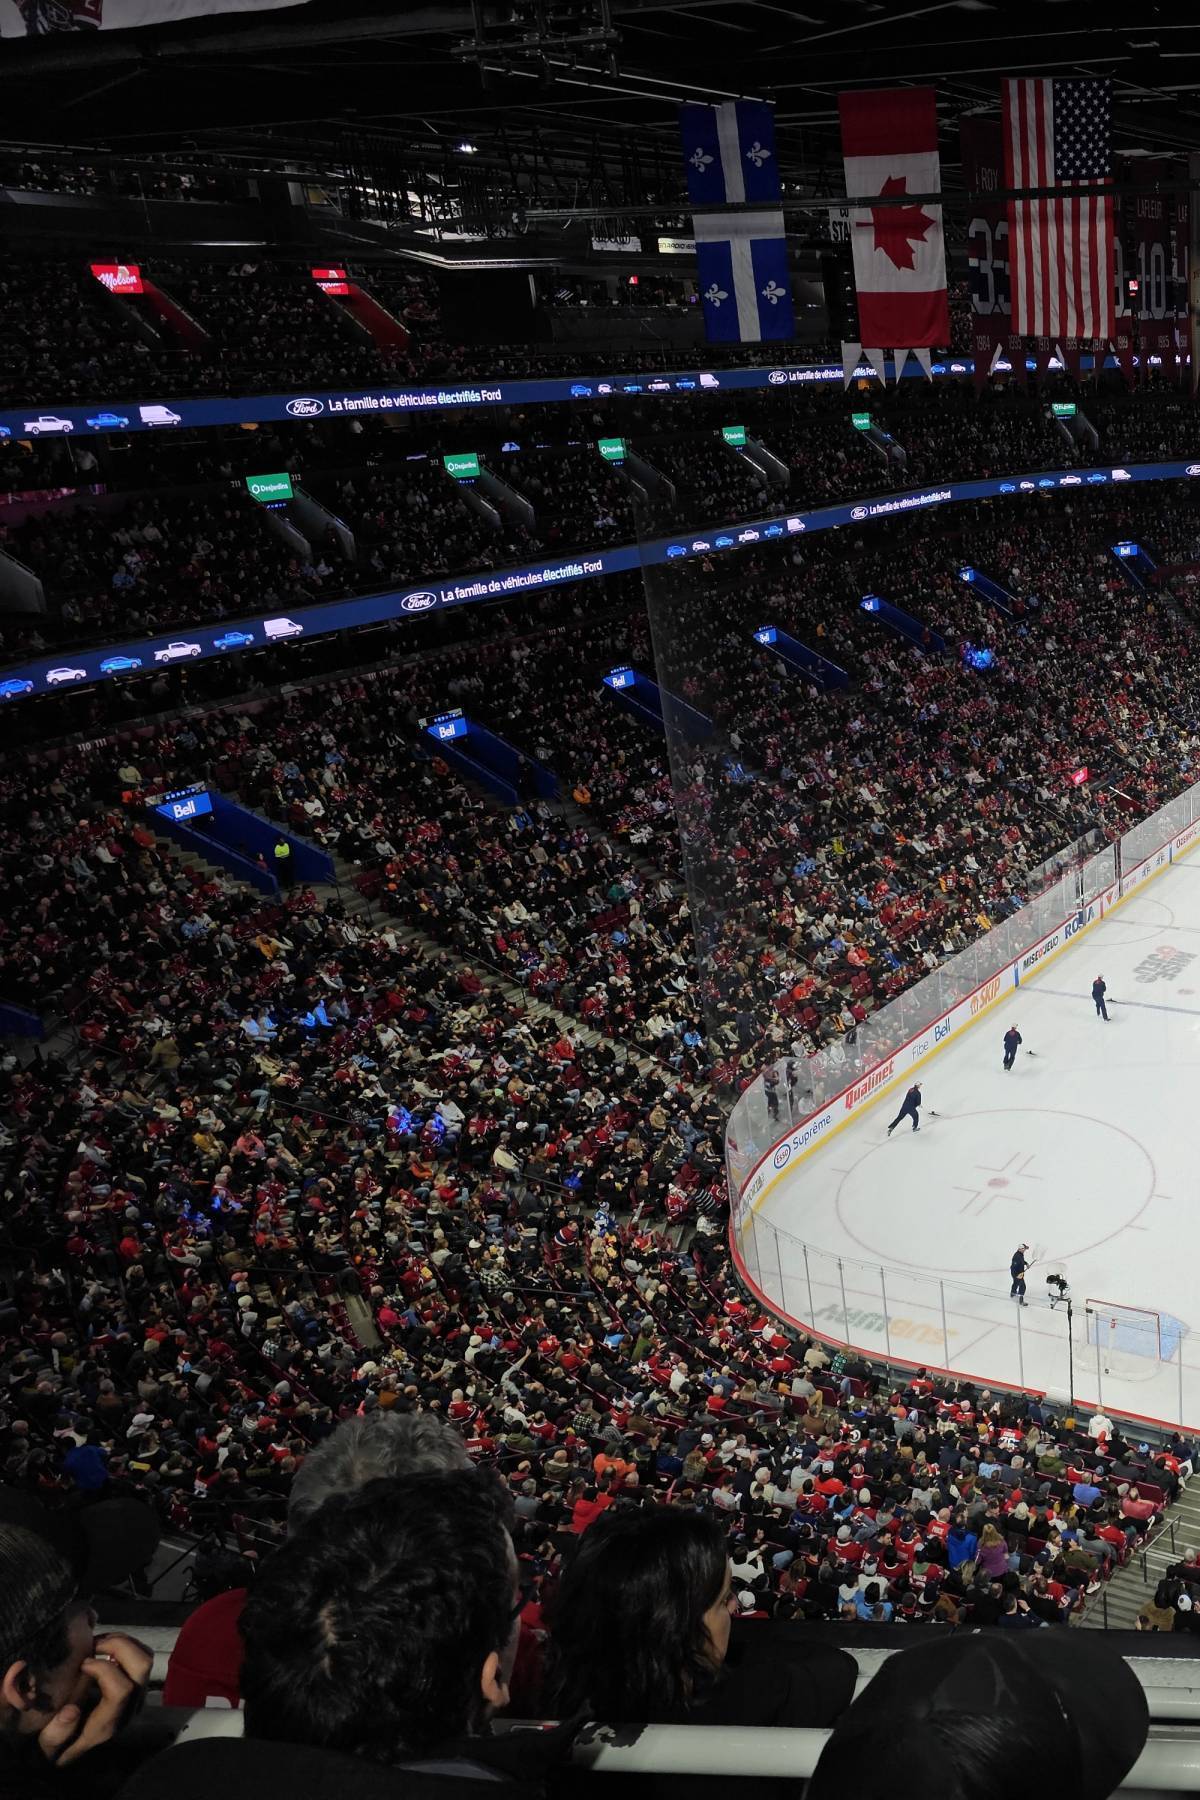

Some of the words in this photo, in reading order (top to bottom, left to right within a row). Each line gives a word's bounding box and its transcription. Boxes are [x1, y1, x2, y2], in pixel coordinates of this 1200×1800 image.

[329, 400, 343, 411] La
[344, 396, 379, 409] famille
[380, 395, 393, 408] de
[394, 393, 437, 407] véhicules
[438, 390, 481, 404] électrifiés
[481, 388, 502, 402] Ford
[261, 484, 288, 492] Desjardins
[440, 590, 455, 602] La
[454, 583, 487, 600] famille
[488, 580, 501, 592] de
[501, 572, 542, 591] véhicules
[542, 564, 583, 581] électrifiés
[583, 559, 603, 574] Ford
[612, 675, 625, 686] Bell
[439, 723, 455, 738] Bell
[173, 800, 195, 818] Bell
[980, 978, 1000, 1006] SKIP
[934, 1018, 951, 1043] Bell
[911, 1040, 929, 1061] Fibe
[845, 1060, 895, 1110] Qualinet
[792, 1113, 832, 1150] Suprême
